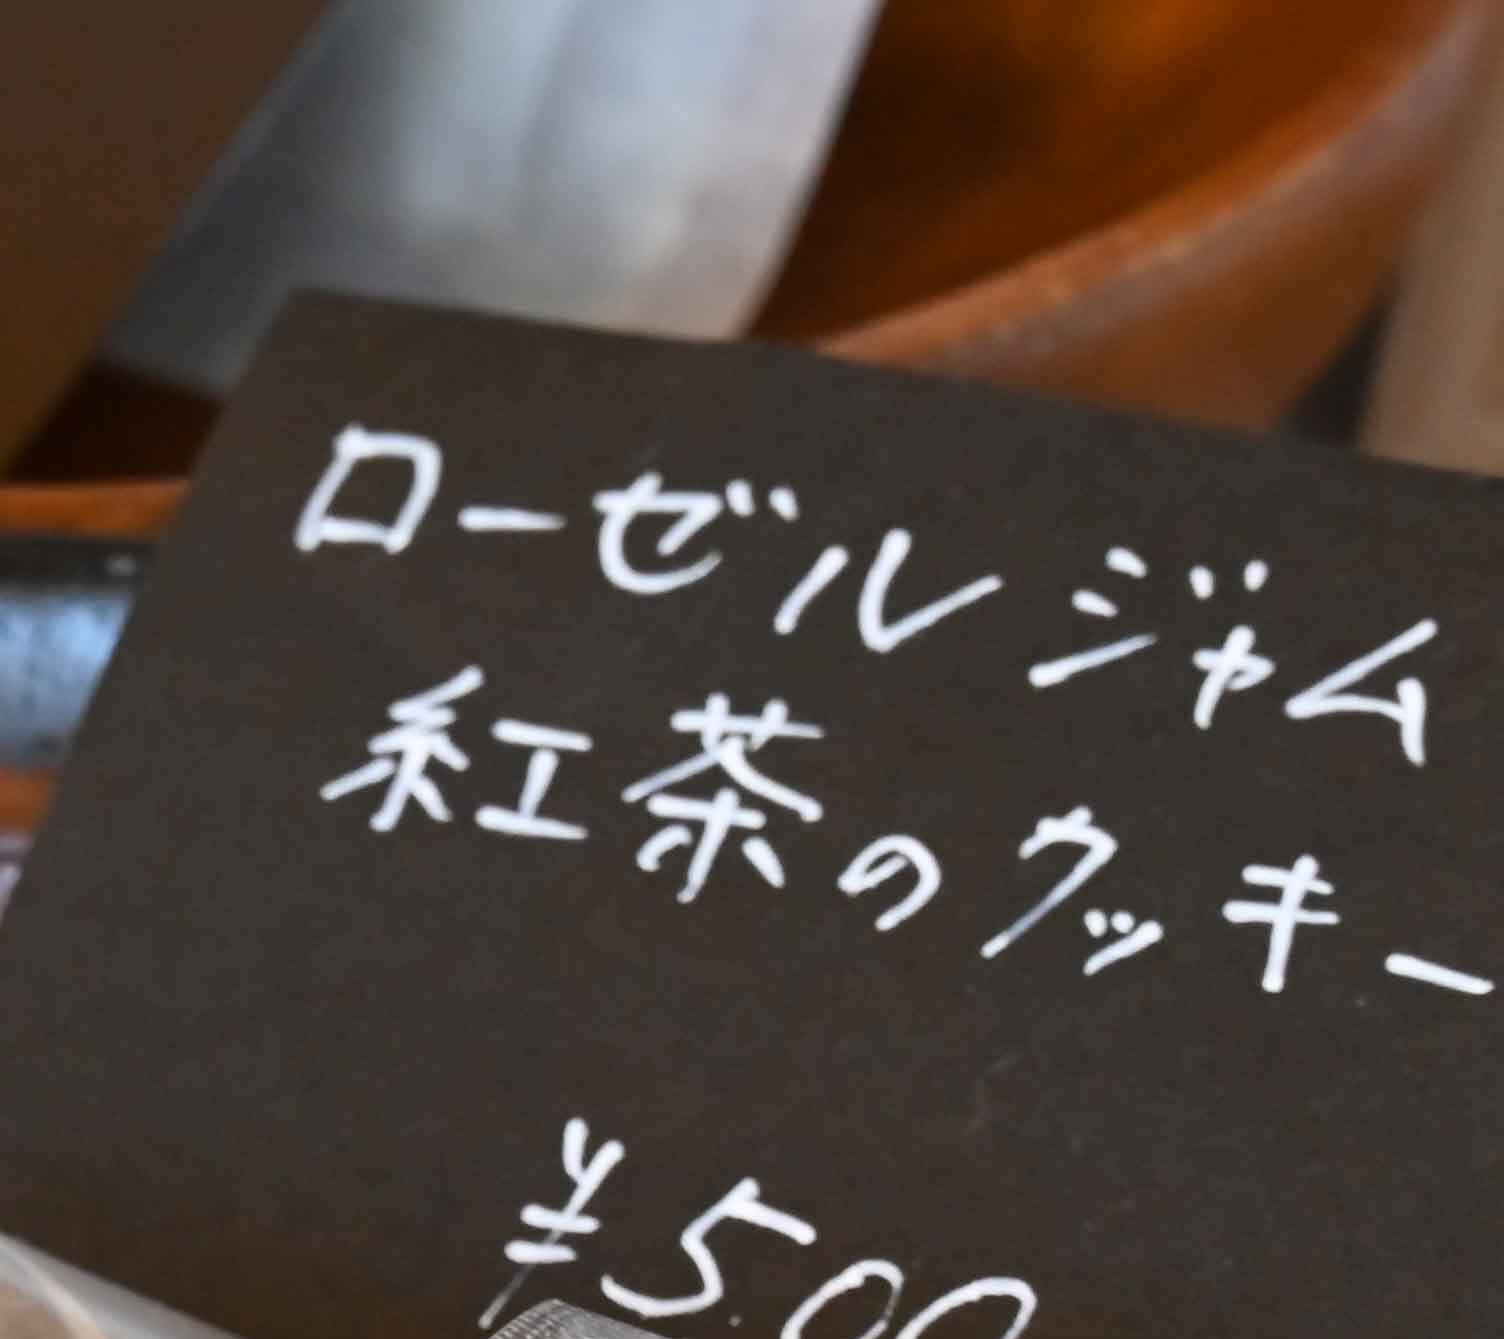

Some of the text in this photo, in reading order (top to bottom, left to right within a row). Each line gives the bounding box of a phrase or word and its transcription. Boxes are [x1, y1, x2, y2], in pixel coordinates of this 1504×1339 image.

[320, 664, 1495, 996] 紅茶のクッキー
